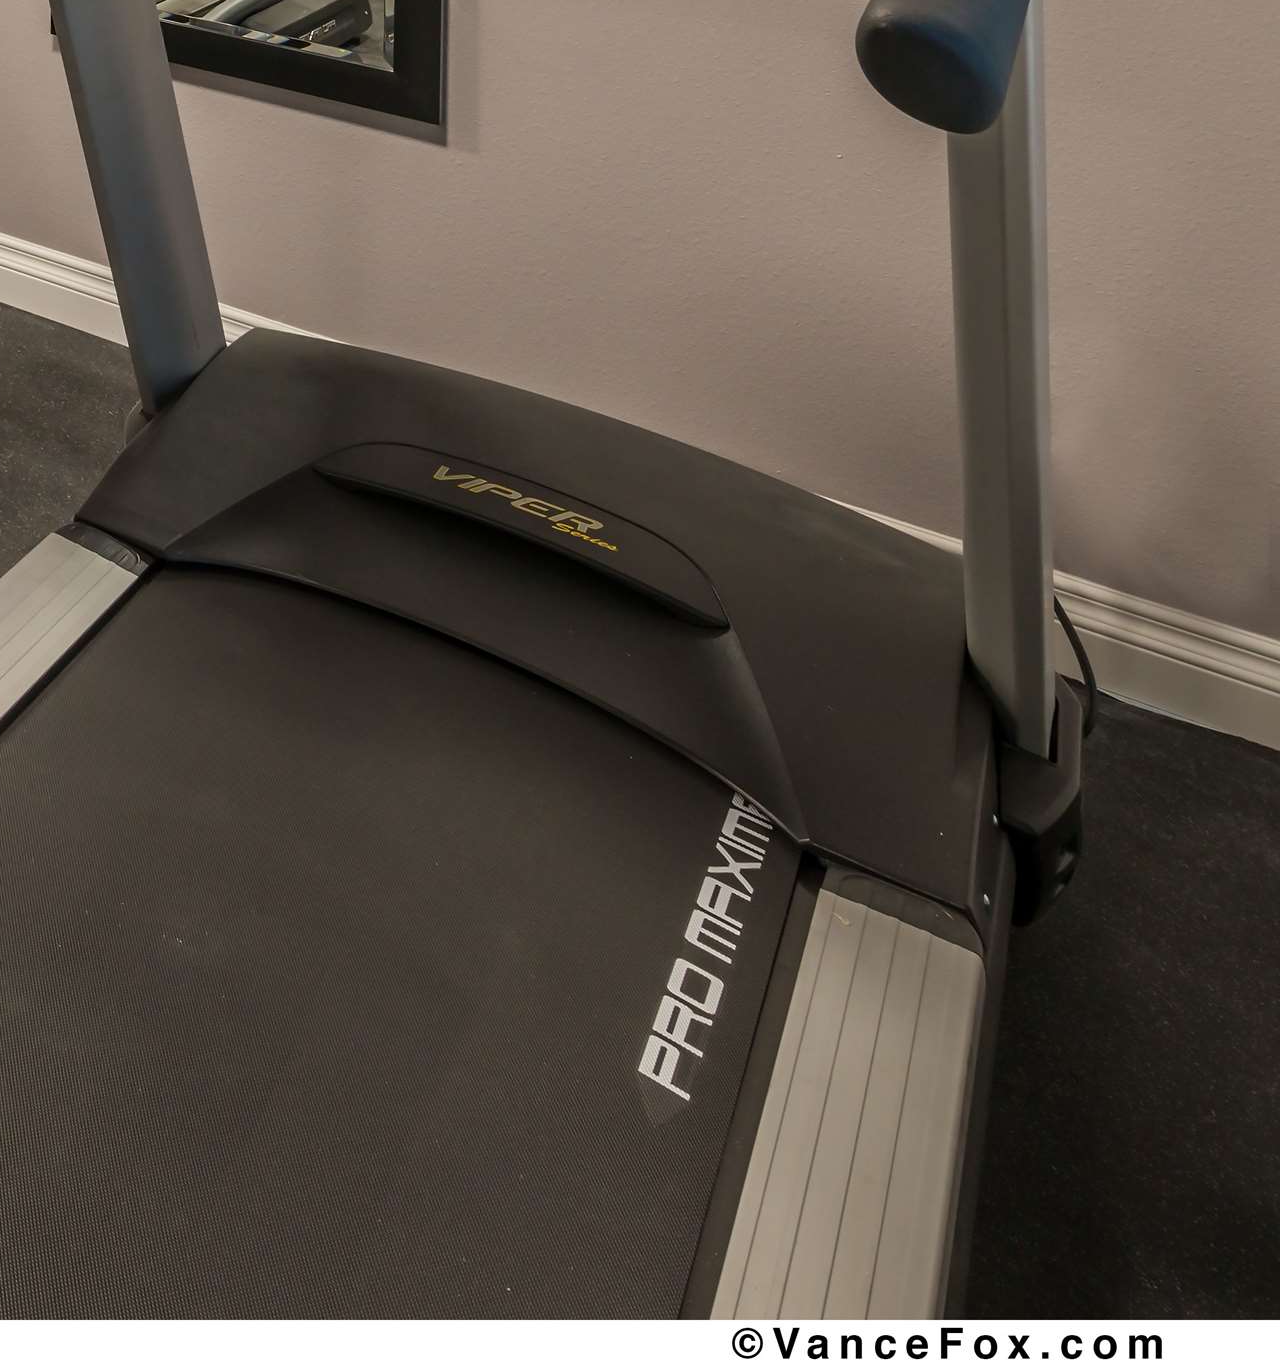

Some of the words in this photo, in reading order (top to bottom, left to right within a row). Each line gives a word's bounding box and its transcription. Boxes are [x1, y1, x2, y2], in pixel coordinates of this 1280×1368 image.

[433, 465, 604, 534] VIPER
[551, 522, 620, 552] Series
[638, 958, 724, 1101] PRO
